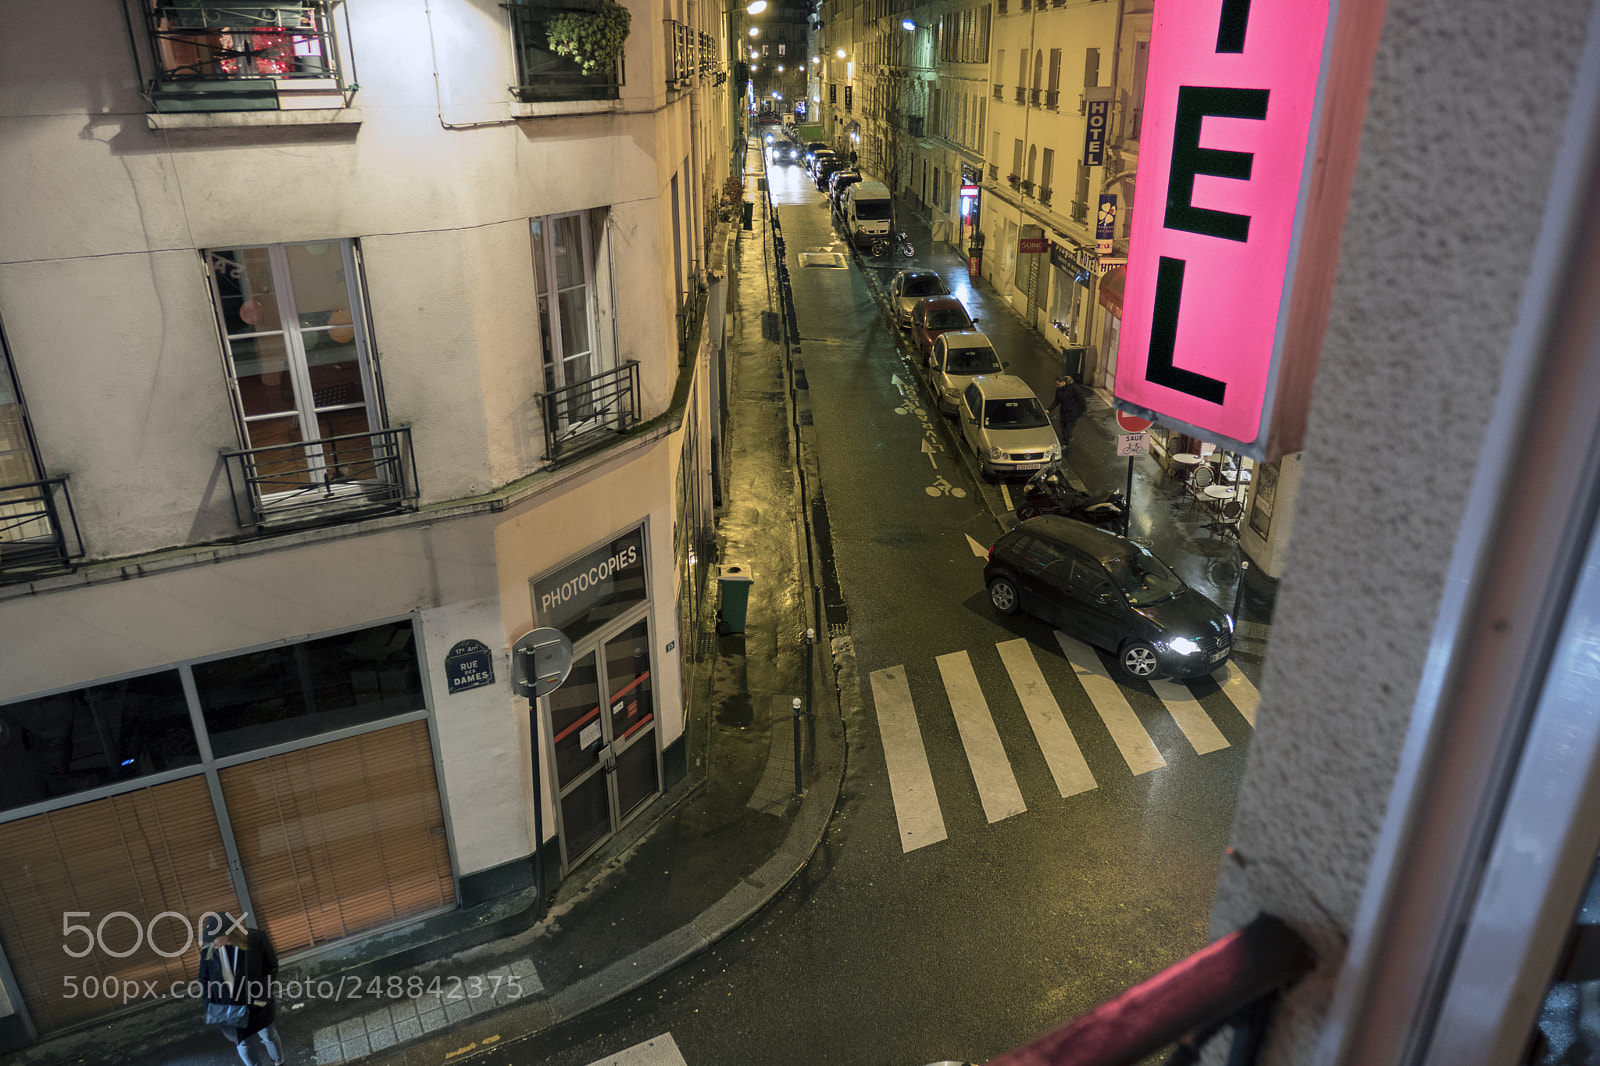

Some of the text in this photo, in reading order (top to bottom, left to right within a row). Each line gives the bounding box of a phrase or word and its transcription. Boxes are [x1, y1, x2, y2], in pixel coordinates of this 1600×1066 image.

[1087, 102, 1105, 165] HOTEL
[541, 545, 637, 613] PHOTOCOPIES
[453, 671, 489, 686] DAMES
[460, 660, 478, 671] RUE
